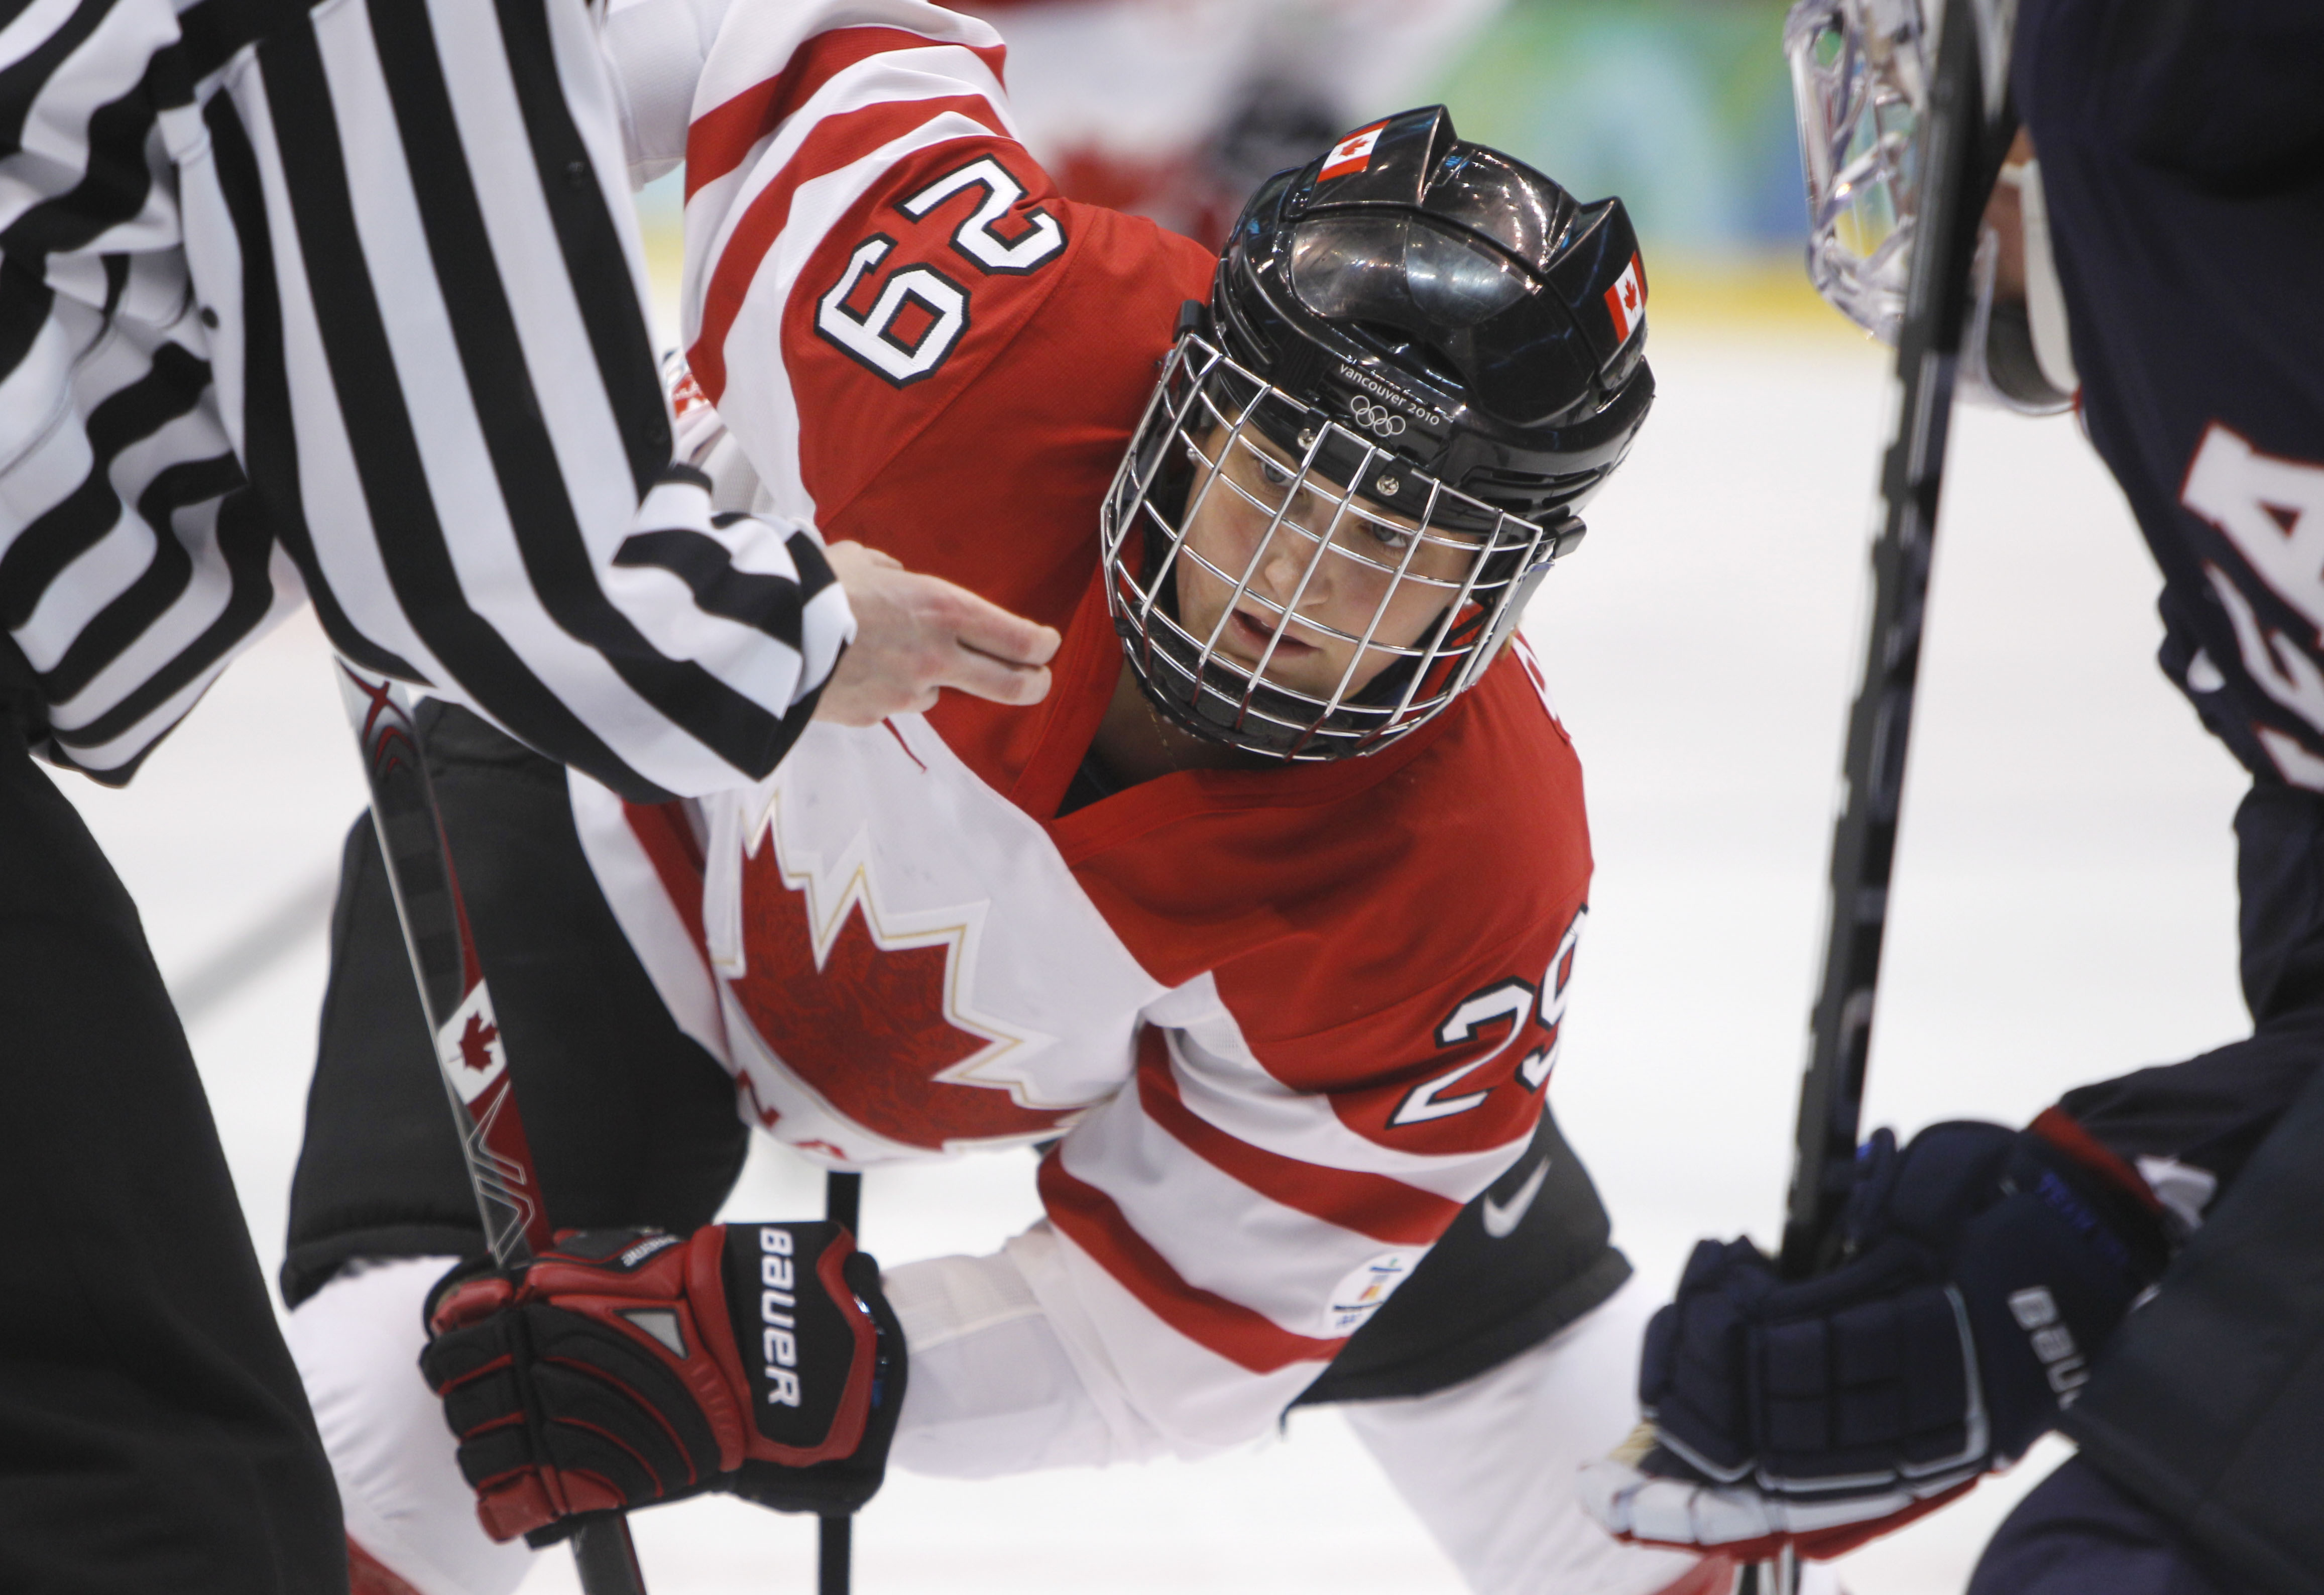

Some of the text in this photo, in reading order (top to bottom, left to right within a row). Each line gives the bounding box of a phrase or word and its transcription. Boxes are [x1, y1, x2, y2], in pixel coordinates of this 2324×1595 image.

[813, 153, 1069, 390] 29
[1339, 363, 1440, 426] vancouver 2010
[1384, 901, 1589, 1130] 29
